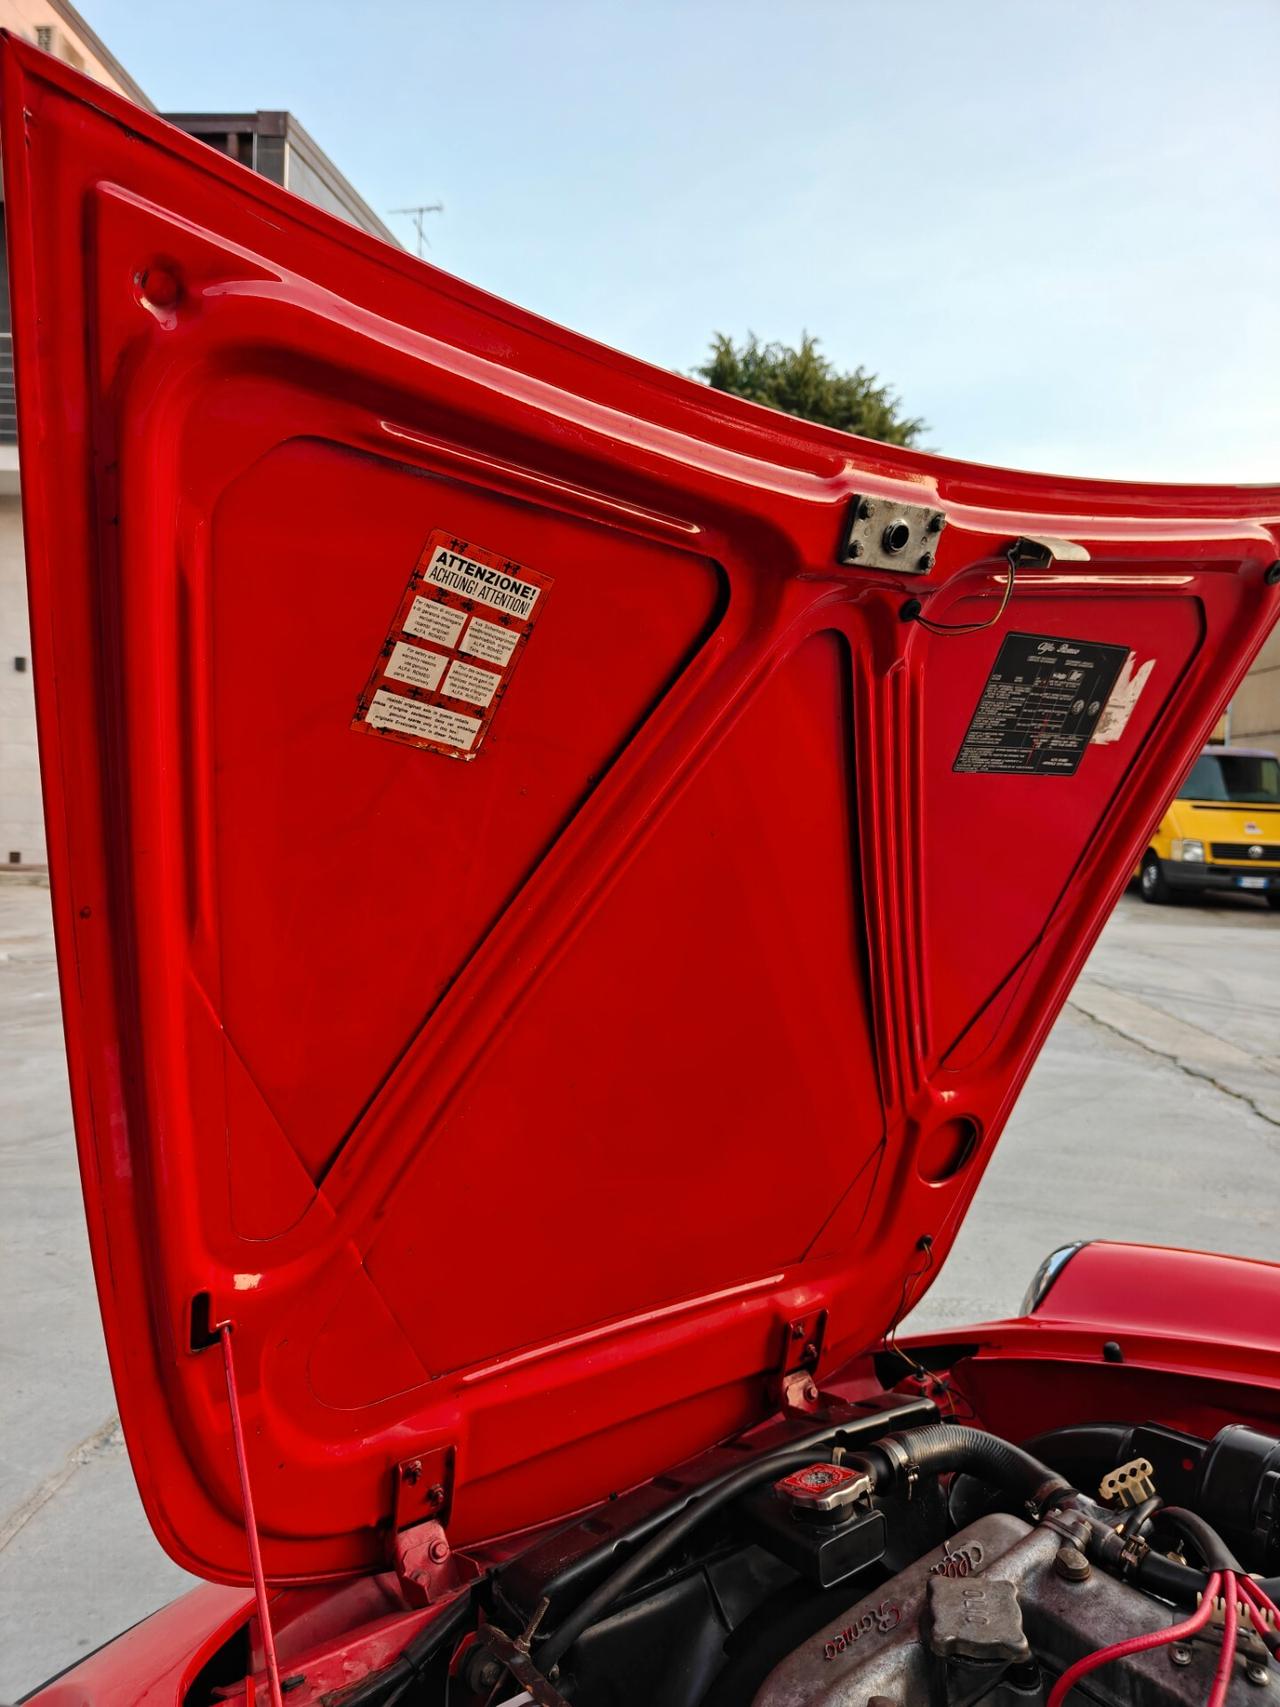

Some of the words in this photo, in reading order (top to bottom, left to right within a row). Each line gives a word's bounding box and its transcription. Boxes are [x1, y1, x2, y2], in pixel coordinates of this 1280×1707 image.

[429, 566, 479, 595] ACHTUNG!
[477, 585, 530, 615] ATTENTION!
[436, 551, 536, 600] ATTENZIONE!
[824, 1599, 900, 1661] Romeo
